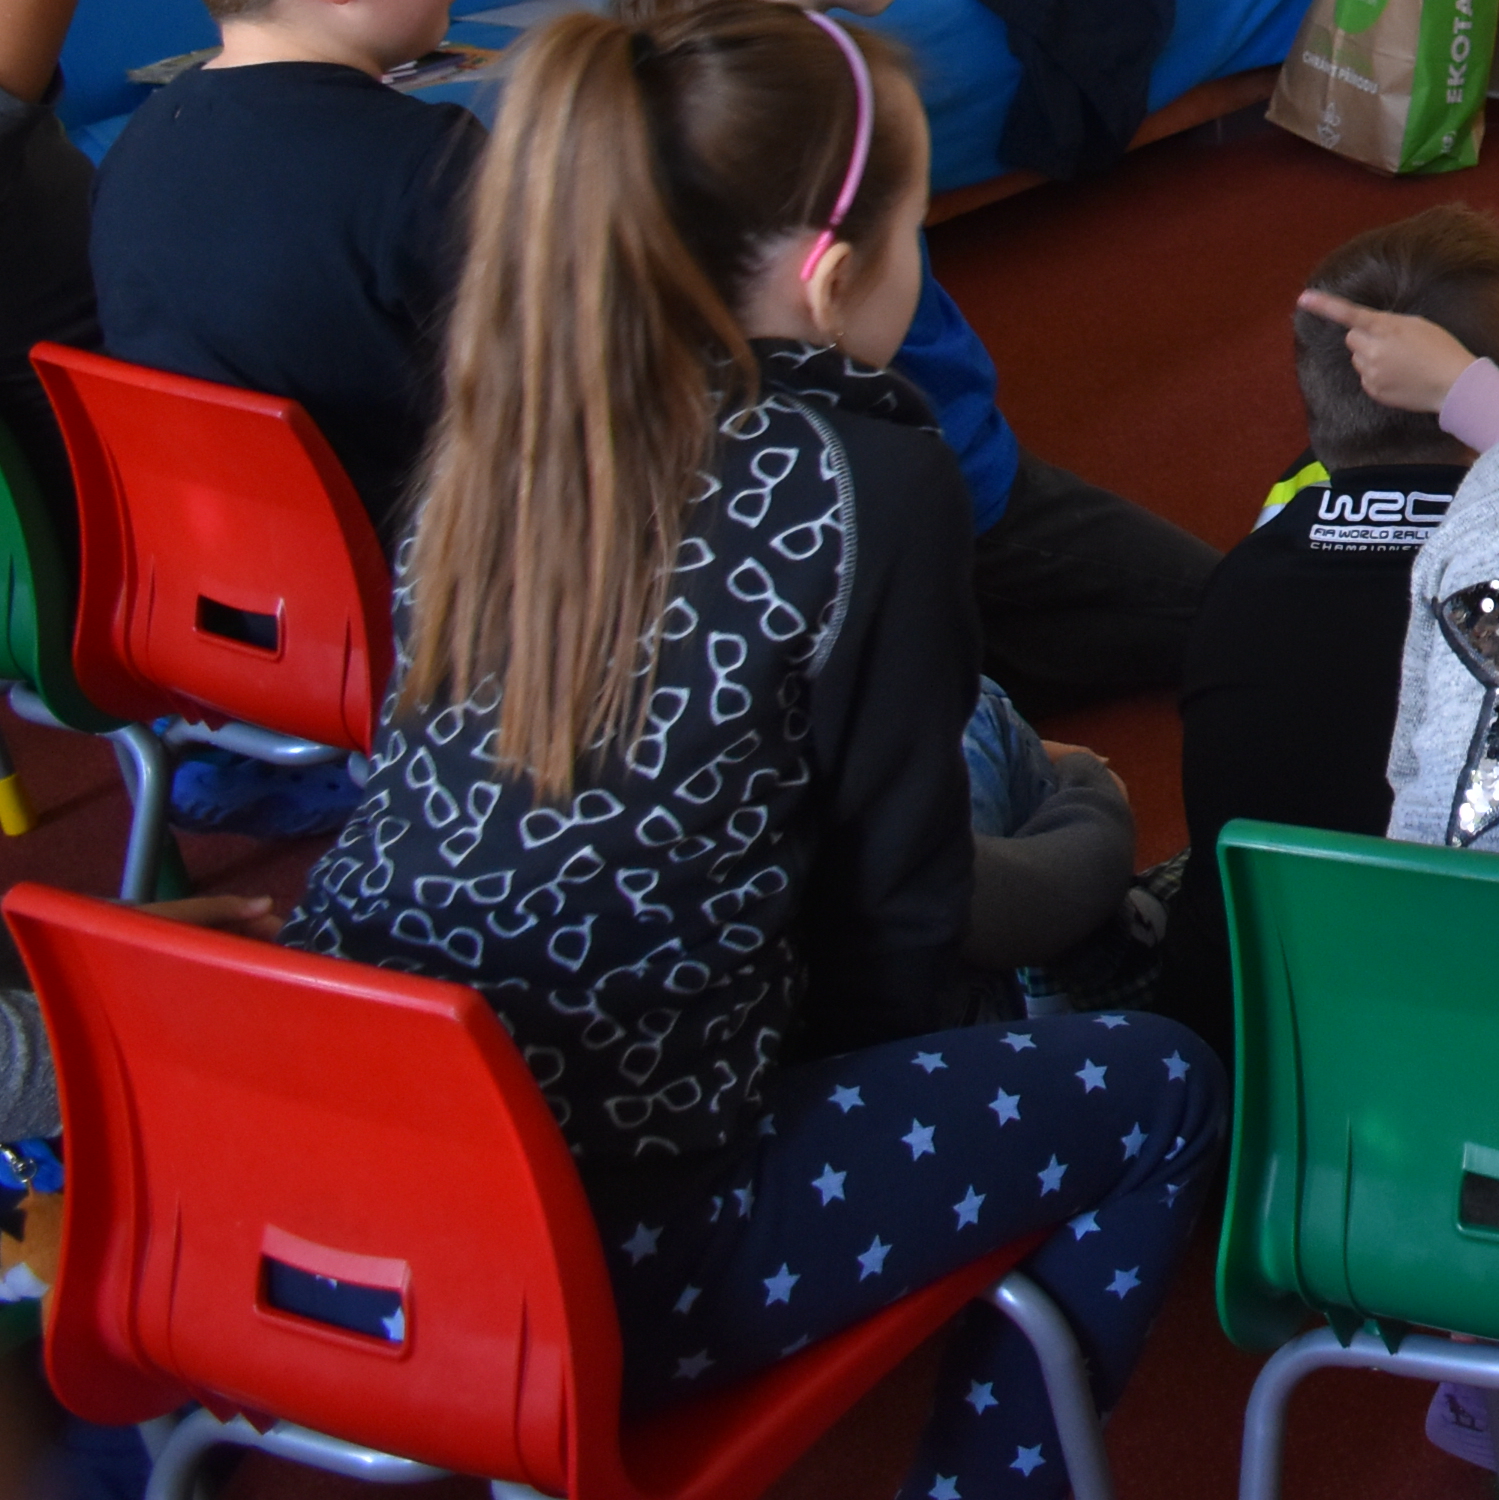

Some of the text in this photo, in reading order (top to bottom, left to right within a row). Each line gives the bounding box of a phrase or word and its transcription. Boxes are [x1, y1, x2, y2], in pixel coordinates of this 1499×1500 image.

[1317, 489, 1453, 522] WRC
[1313, 527, 1431, 540] FIA WORLD RALL
[1310, 542, 1421, 551] CHAMPIONS
